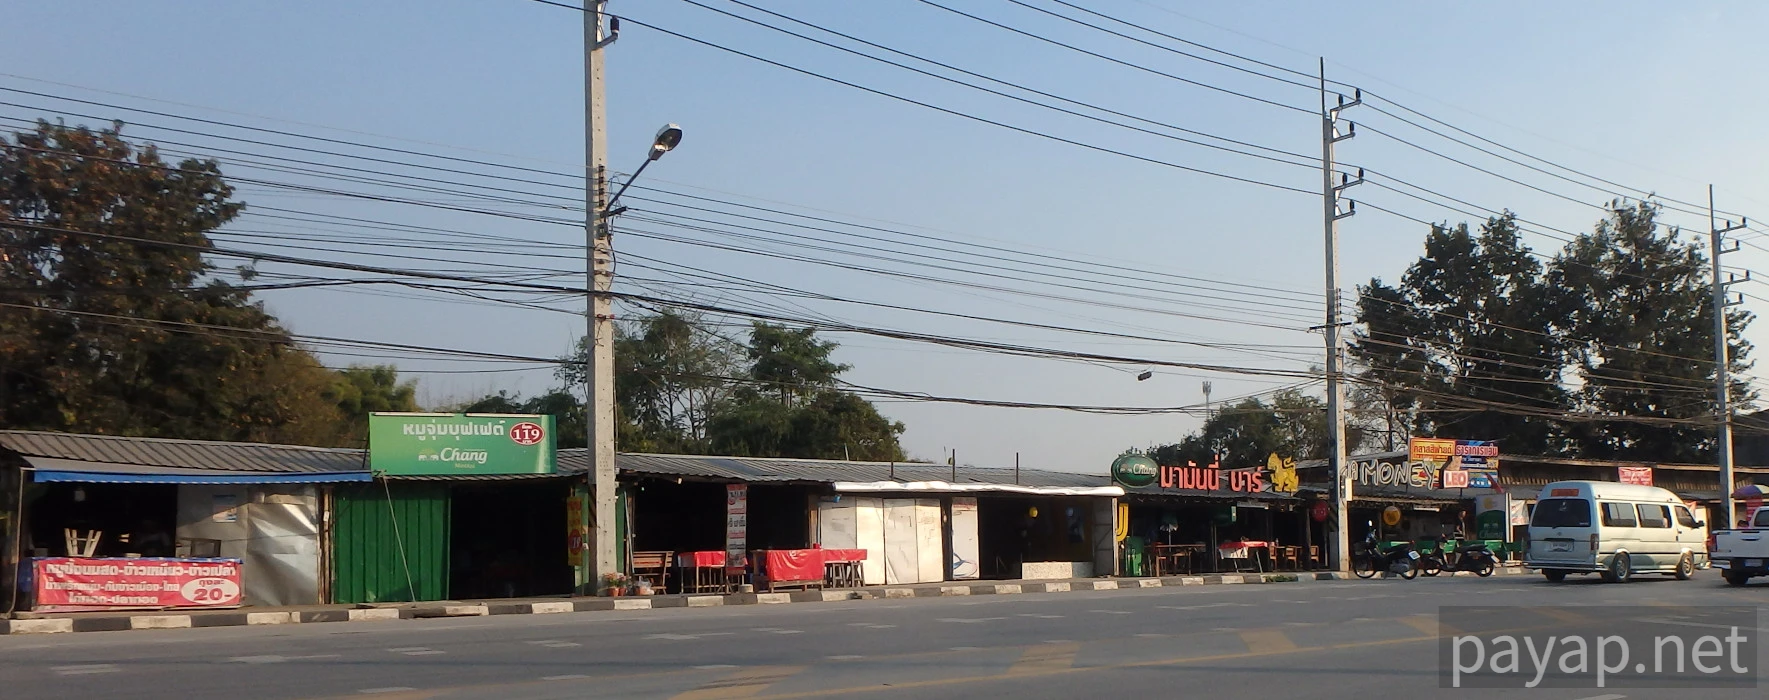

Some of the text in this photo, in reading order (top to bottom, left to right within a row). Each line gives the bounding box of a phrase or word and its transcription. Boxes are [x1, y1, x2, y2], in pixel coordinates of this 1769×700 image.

[403, 419, 506, 441] หมูจุ่มบุฟเฟต์
[513, 429, 540, 440] 119
[440, 447, 488, 464] Chang
[1133, 463, 1157, 477] Chang
[1160, 454, 1264, 493] มามันนี่ บาร์
[1360, 459, 1437, 491] MONEY
[1445, 472, 1467, 487] LEO
